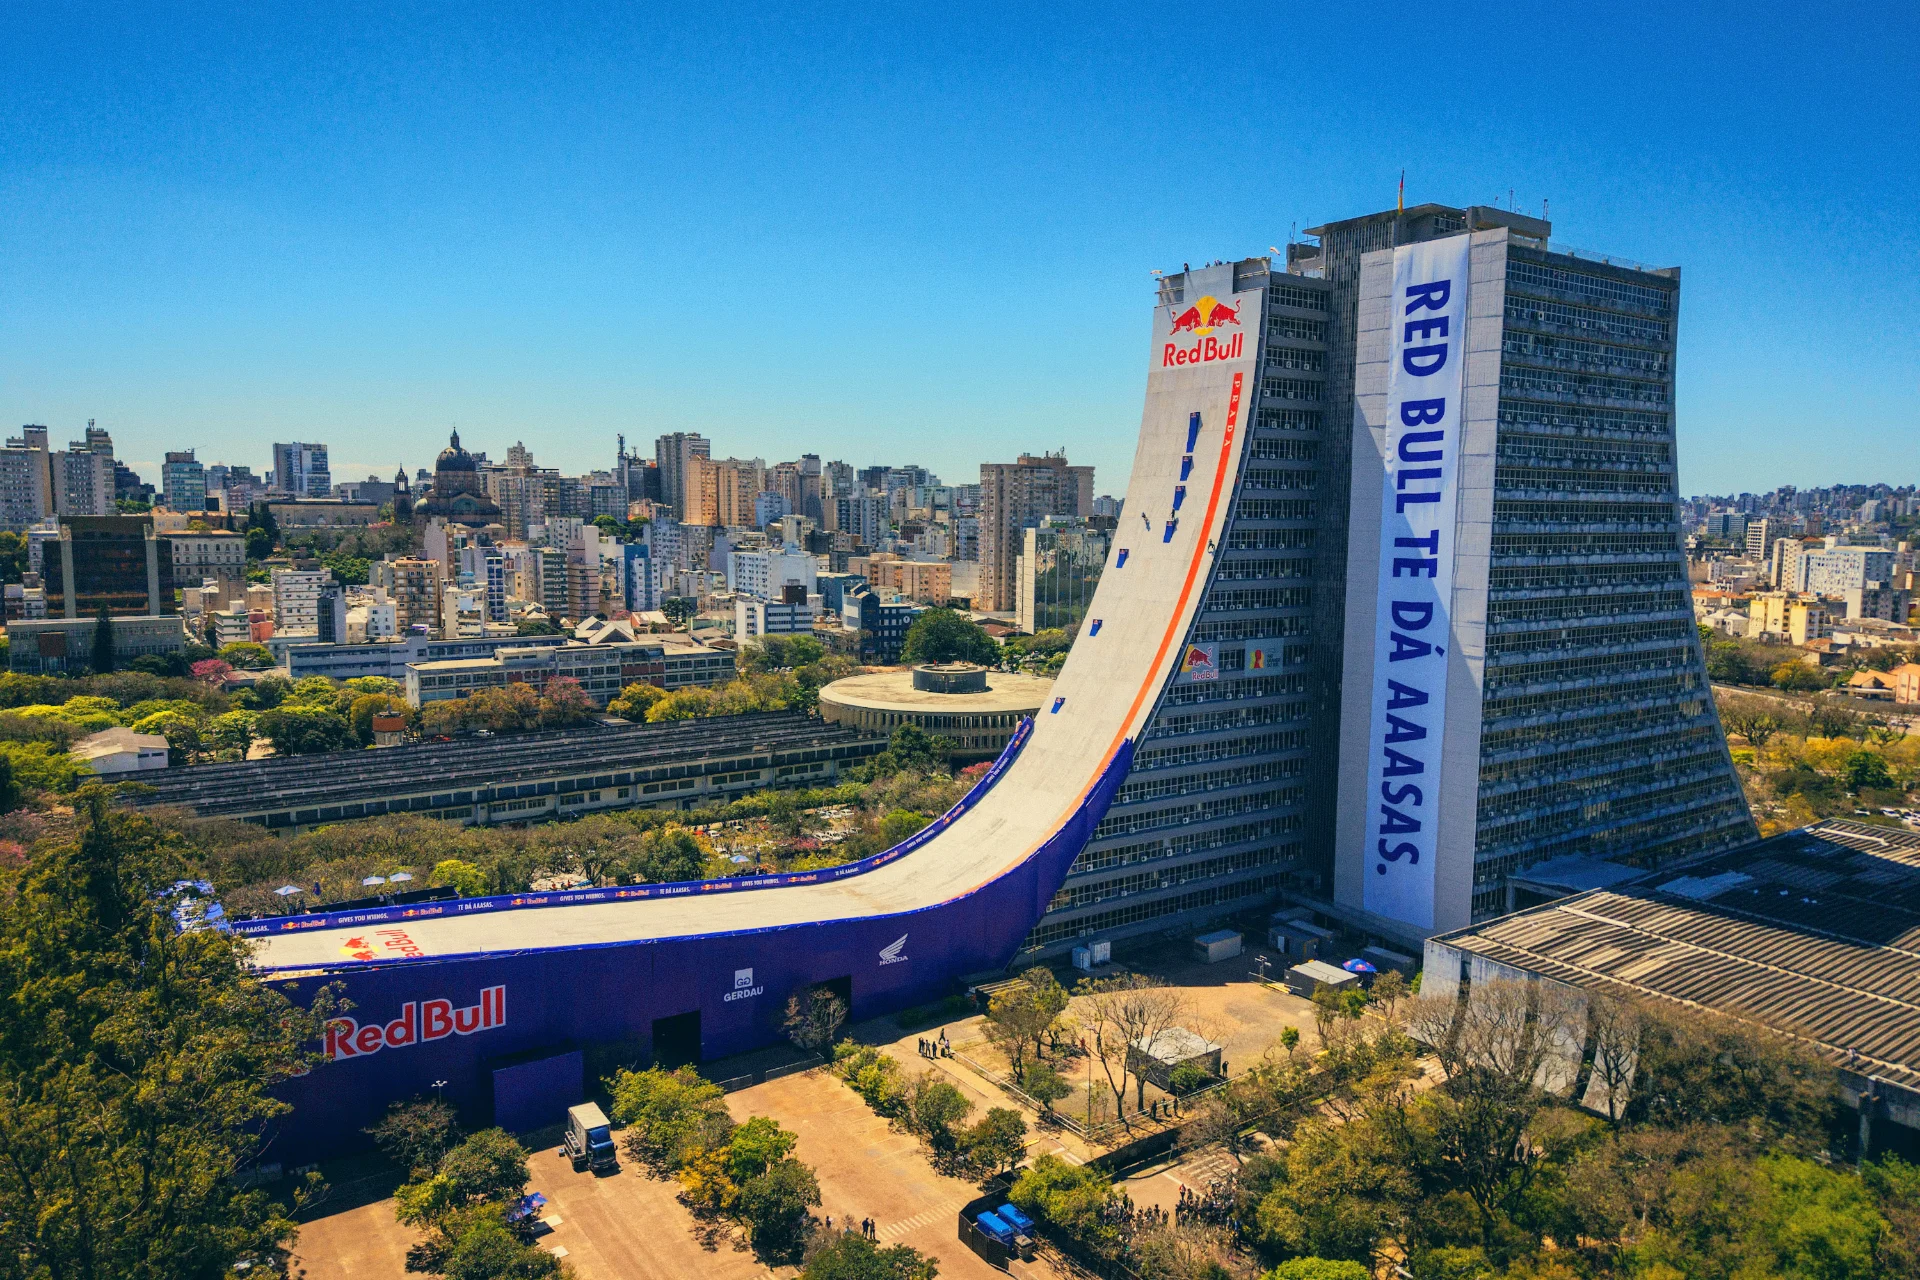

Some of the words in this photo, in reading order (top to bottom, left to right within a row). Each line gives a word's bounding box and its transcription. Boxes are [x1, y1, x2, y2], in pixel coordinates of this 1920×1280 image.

[1402, 279, 1451, 377] RED
[1223, 380, 1241, 447] PRADA
[1395, 397, 1446, 514] BULL
[1392, 529, 1439, 578] TE
[1389, 600, 1445, 662] DÁ
[1376, 678, 1429, 876] AAASAS.
[879, 955, 909, 966] HONDA
[723, 986, 764, 1002] GERDAU
